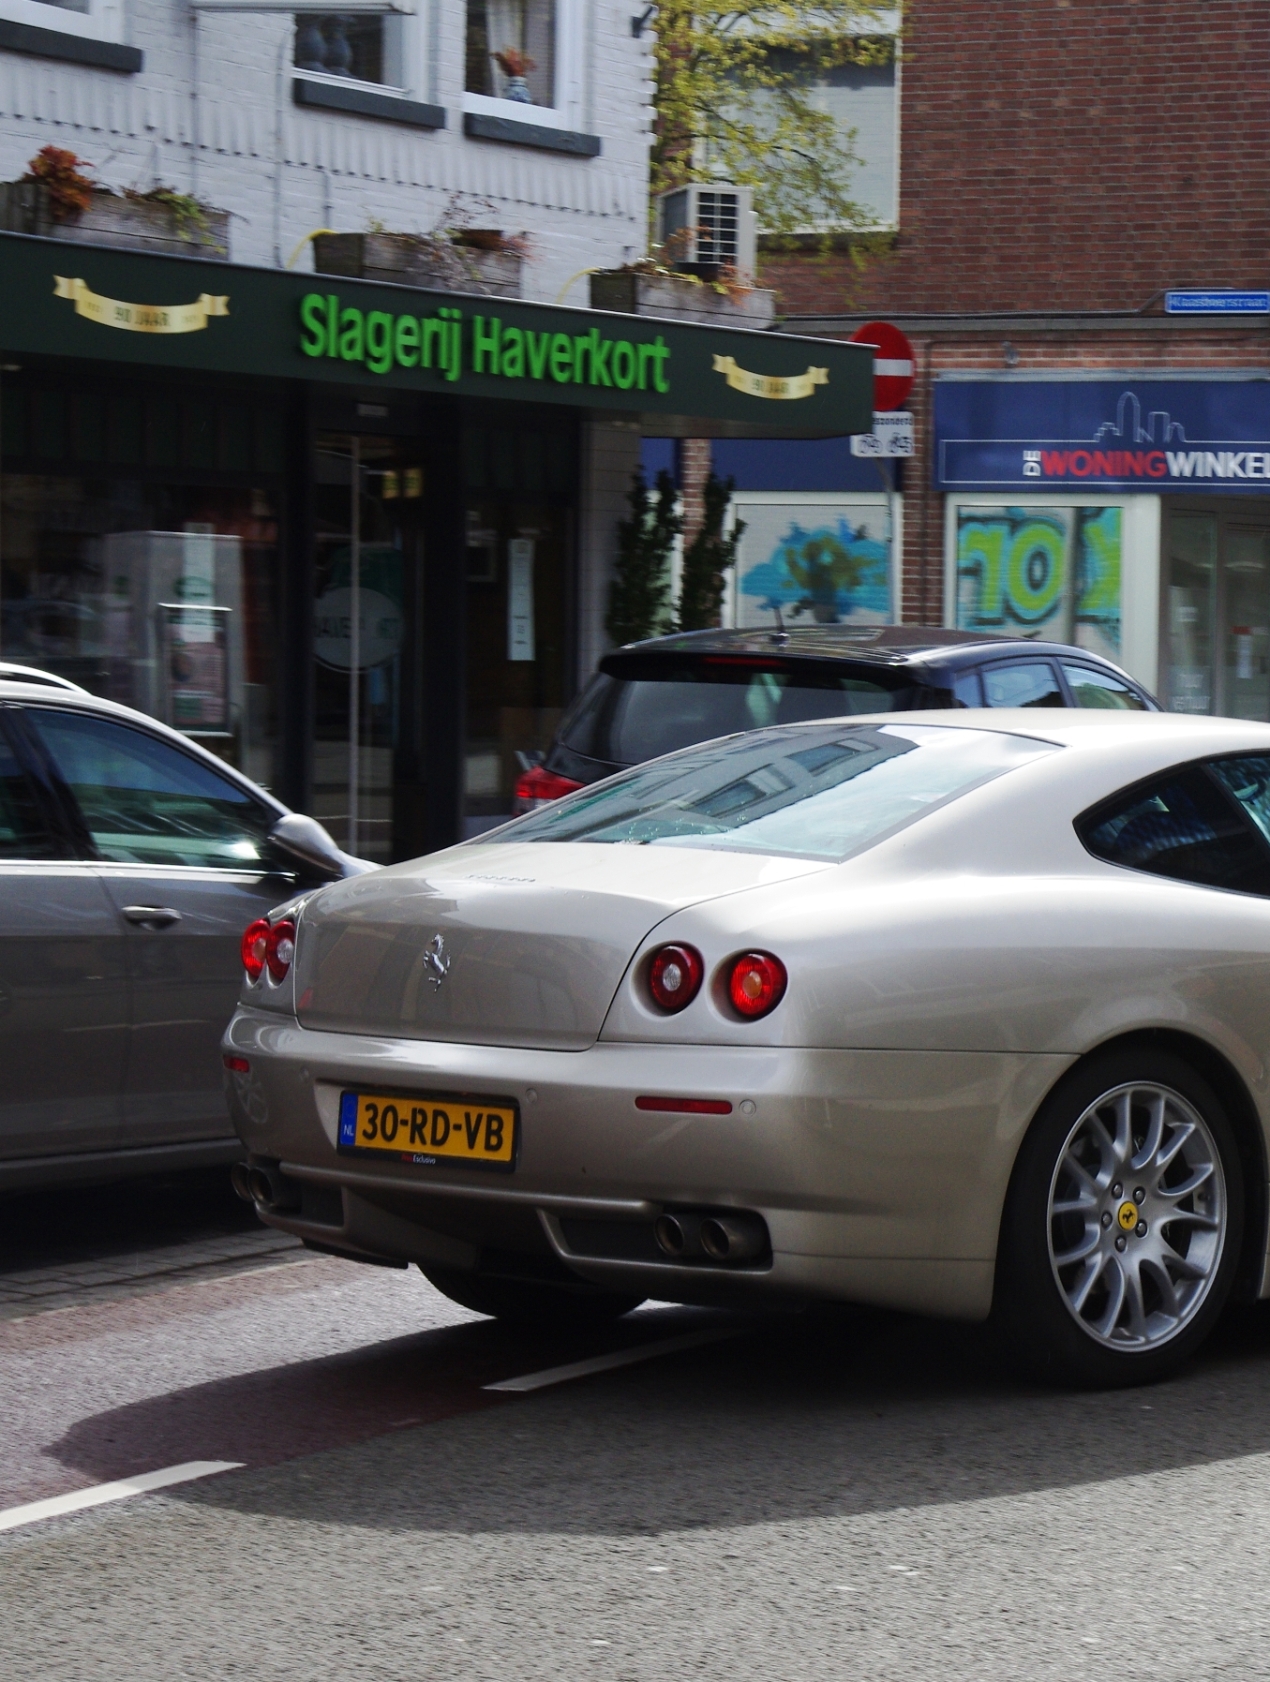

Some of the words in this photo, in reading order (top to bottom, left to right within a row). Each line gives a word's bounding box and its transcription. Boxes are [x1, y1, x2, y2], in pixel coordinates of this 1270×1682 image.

[301, 293, 462, 382] Slagerij
[473, 315, 670, 393] Haverkort
[1022, 450, 1041, 476] DE
[343, 1124, 354, 1136] NL
[362, 1102, 504, 1152] 30-RD-VB
